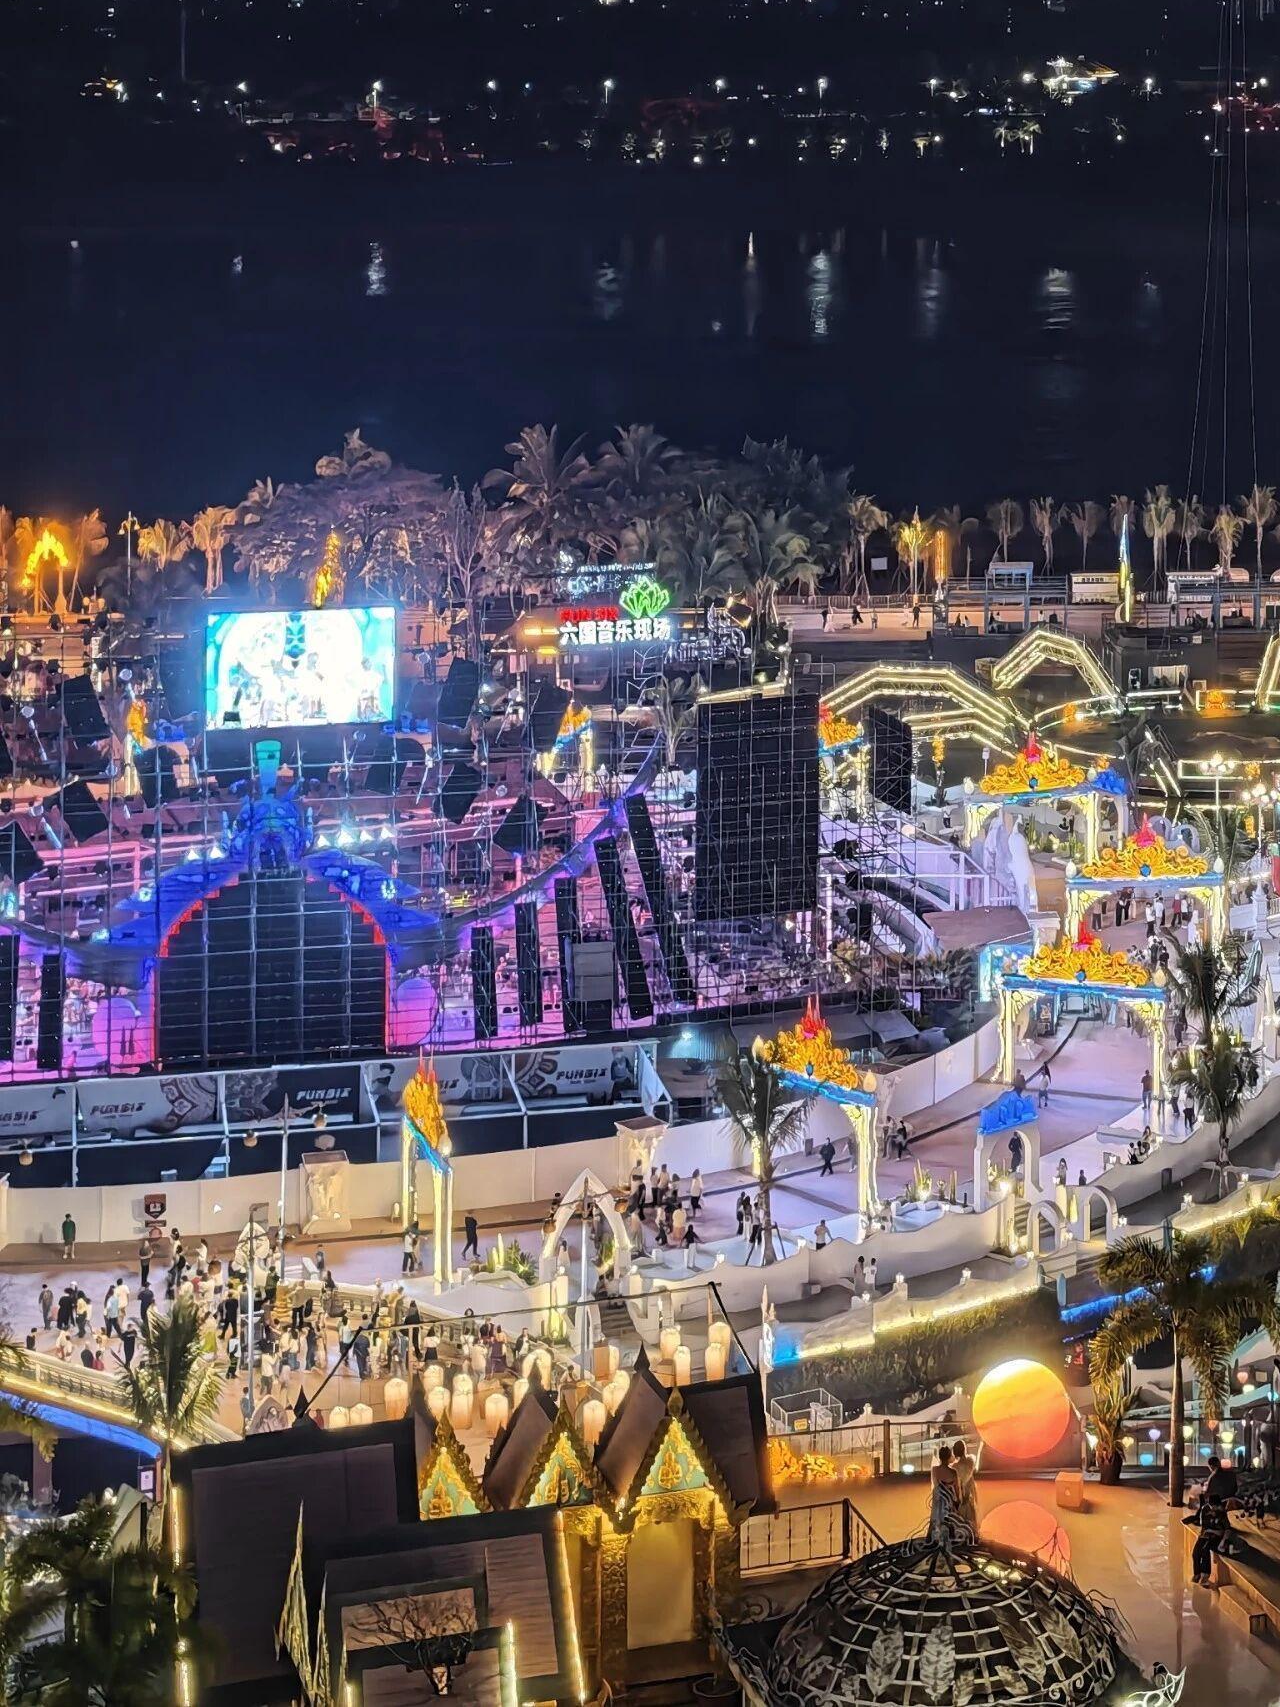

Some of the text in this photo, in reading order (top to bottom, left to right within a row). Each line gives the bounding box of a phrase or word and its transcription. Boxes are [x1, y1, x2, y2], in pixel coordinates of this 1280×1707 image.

[559, 618, 670, 646] 六国音乐现场
